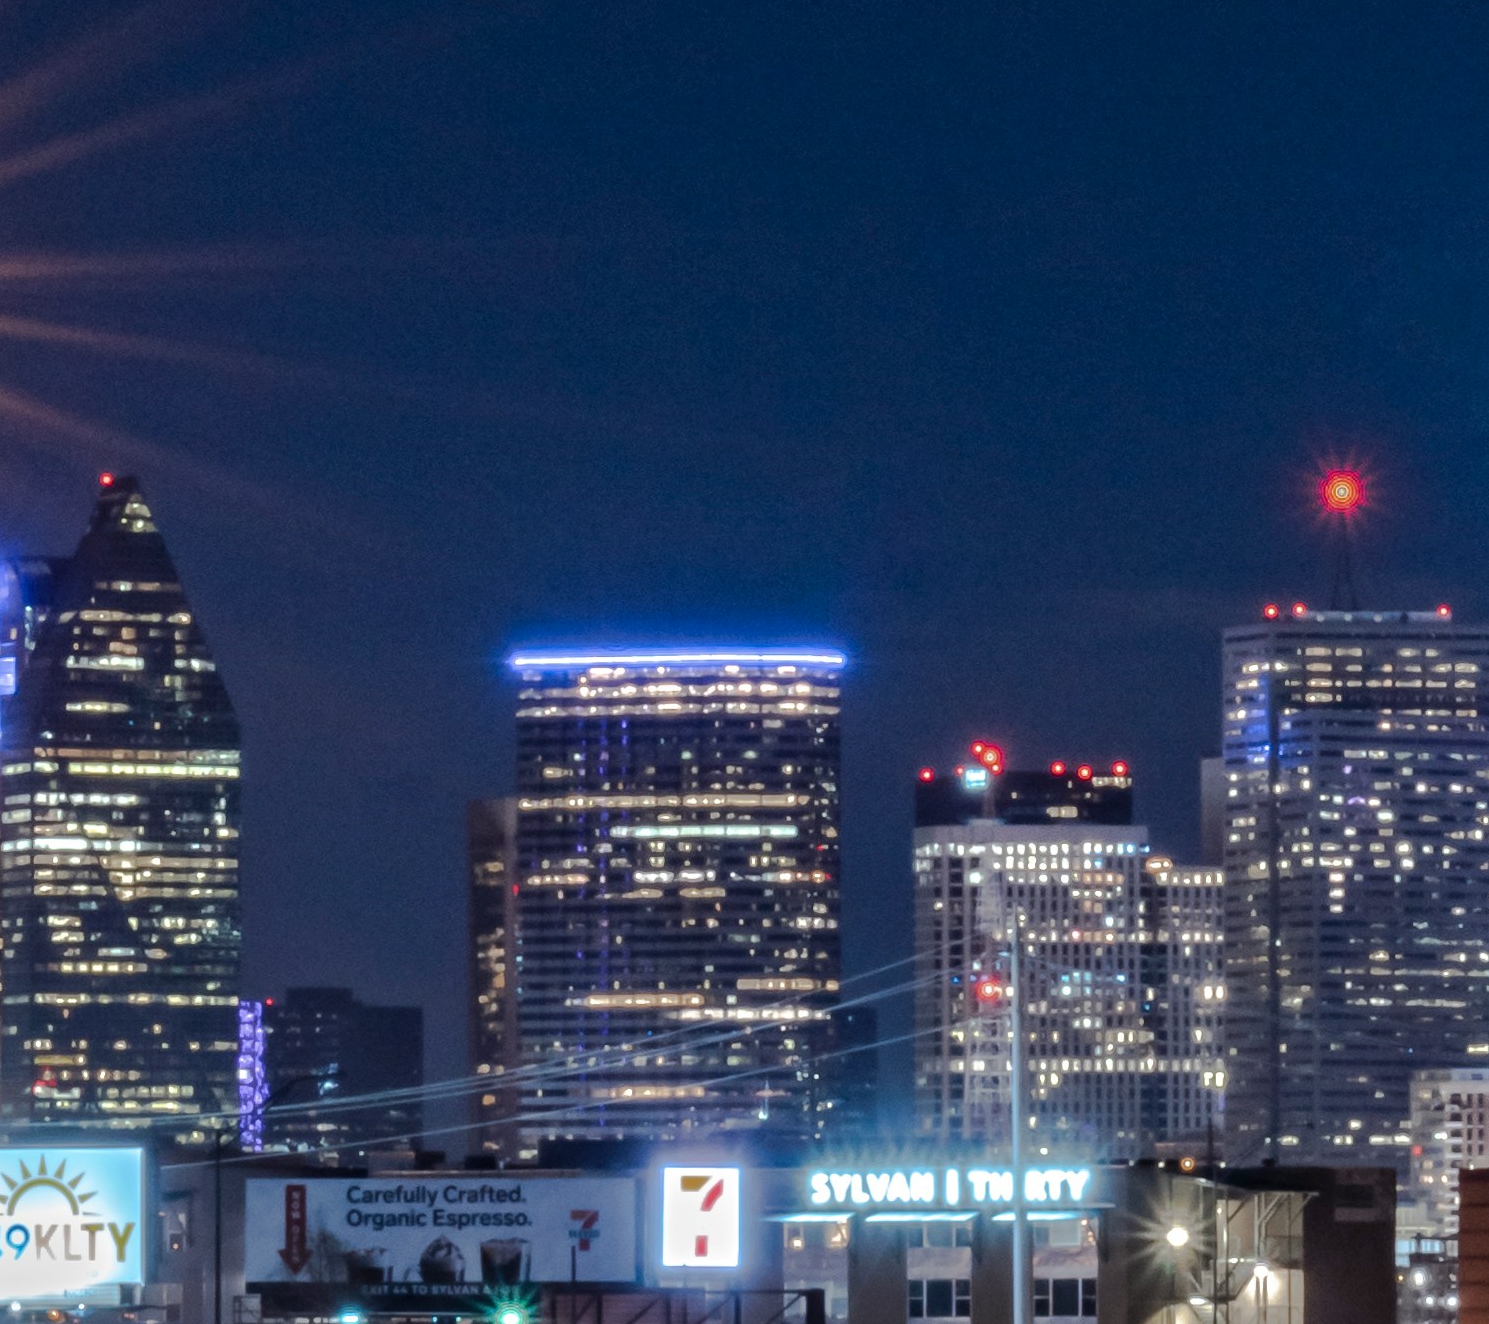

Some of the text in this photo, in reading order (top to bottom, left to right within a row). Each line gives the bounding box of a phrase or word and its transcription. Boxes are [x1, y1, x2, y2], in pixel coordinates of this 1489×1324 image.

[346, 1184, 526, 1207] Carefully Crafted.
[810, 1171, 935, 1204] SYLVAN
[967, 1168, 1091, 1202] THRTY
[346, 1208, 532, 1231] Organic Espresso.
